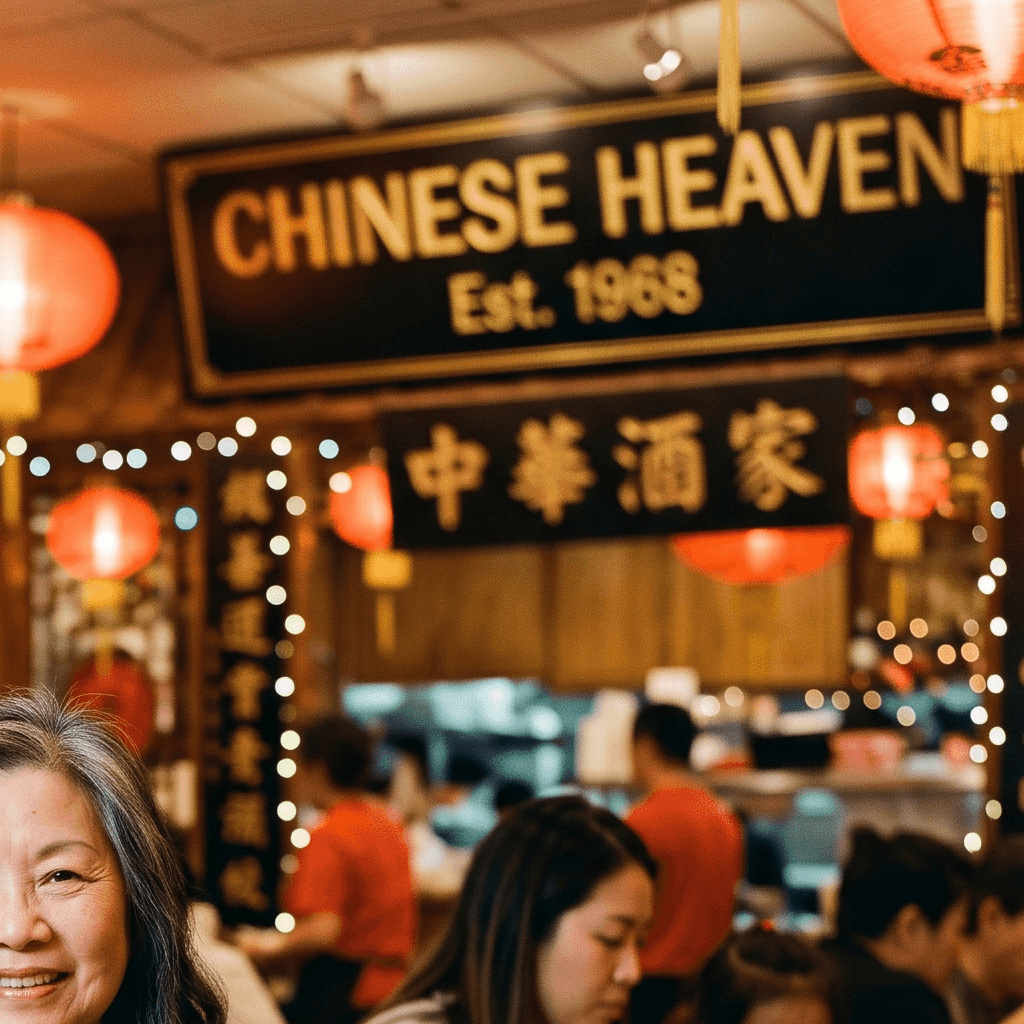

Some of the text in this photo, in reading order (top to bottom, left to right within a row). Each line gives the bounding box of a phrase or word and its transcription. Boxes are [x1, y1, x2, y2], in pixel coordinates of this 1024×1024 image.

[213, 107, 965, 278] CHINESE HEAVEN
[447, 250, 702, 336] Est. 1968
[403, 399, 823, 531] 中華酒家
